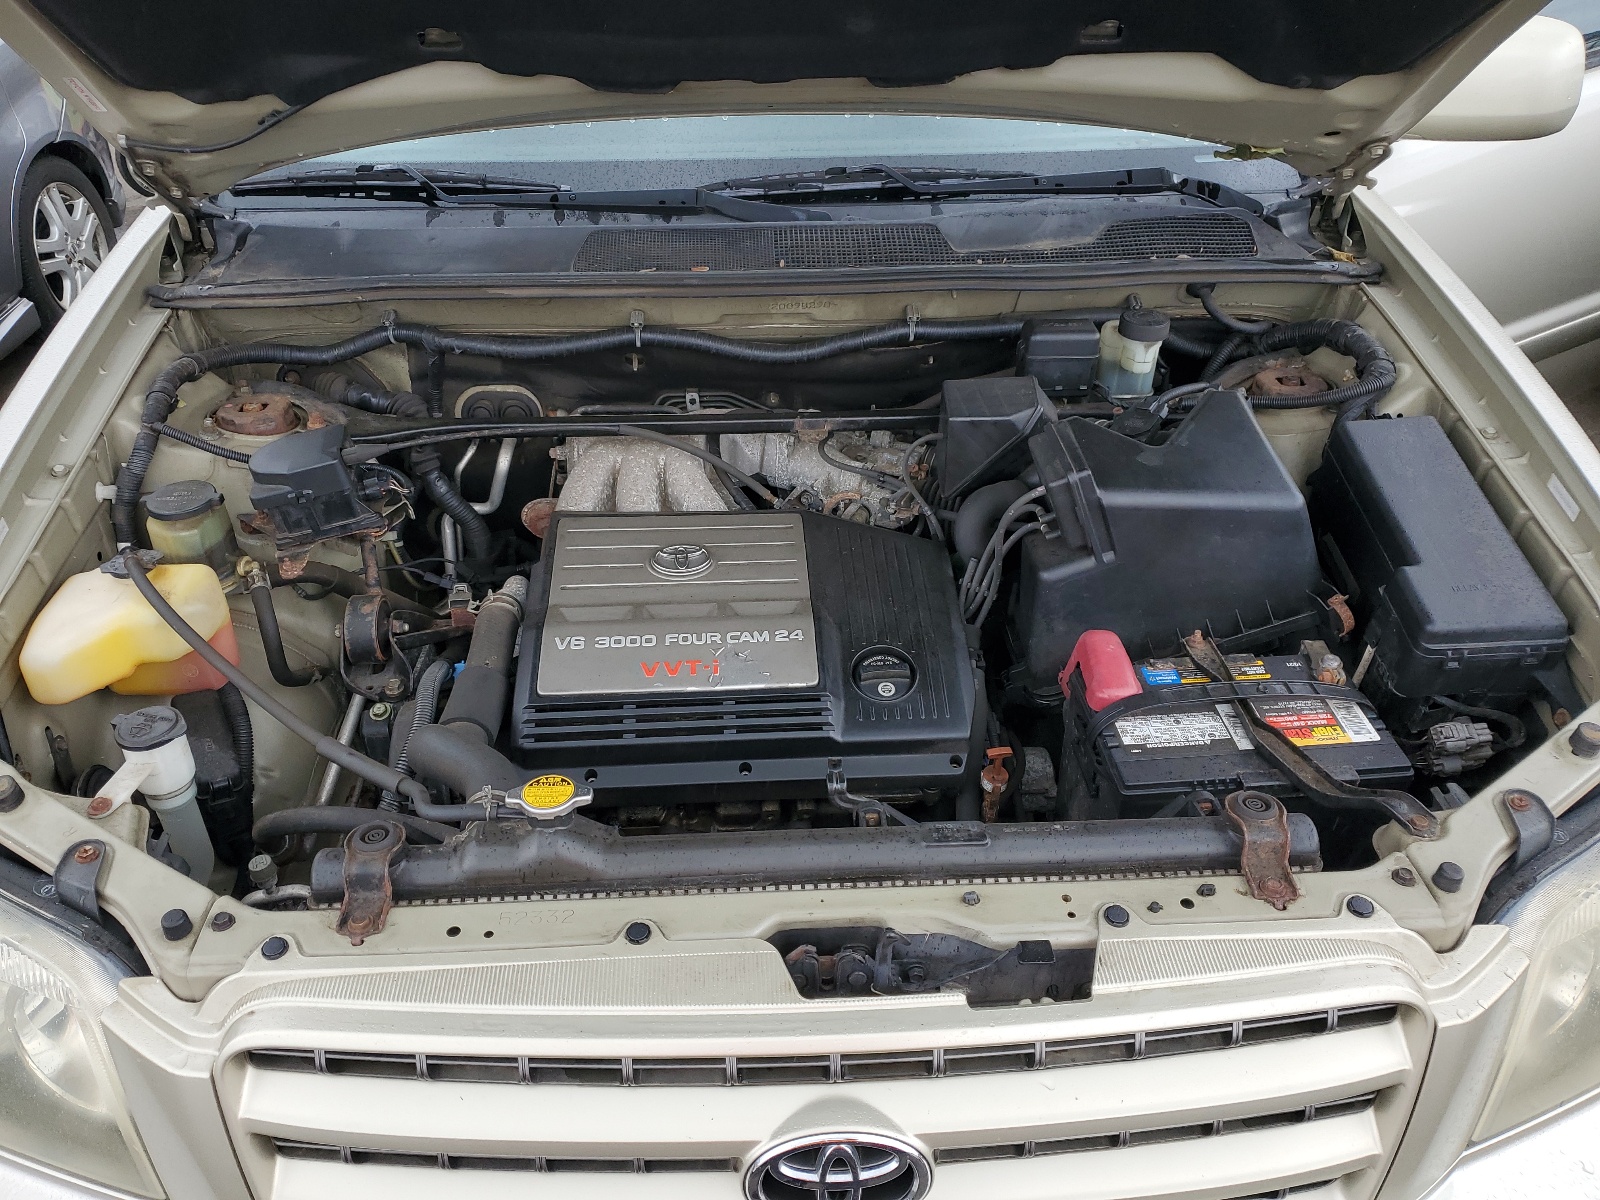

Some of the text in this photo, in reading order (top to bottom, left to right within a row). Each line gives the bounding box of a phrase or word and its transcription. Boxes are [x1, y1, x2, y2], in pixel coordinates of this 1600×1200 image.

[554, 629, 805, 650] V6 3000 FOUR CAM 24
[640, 658, 721, 678] VVT-i
